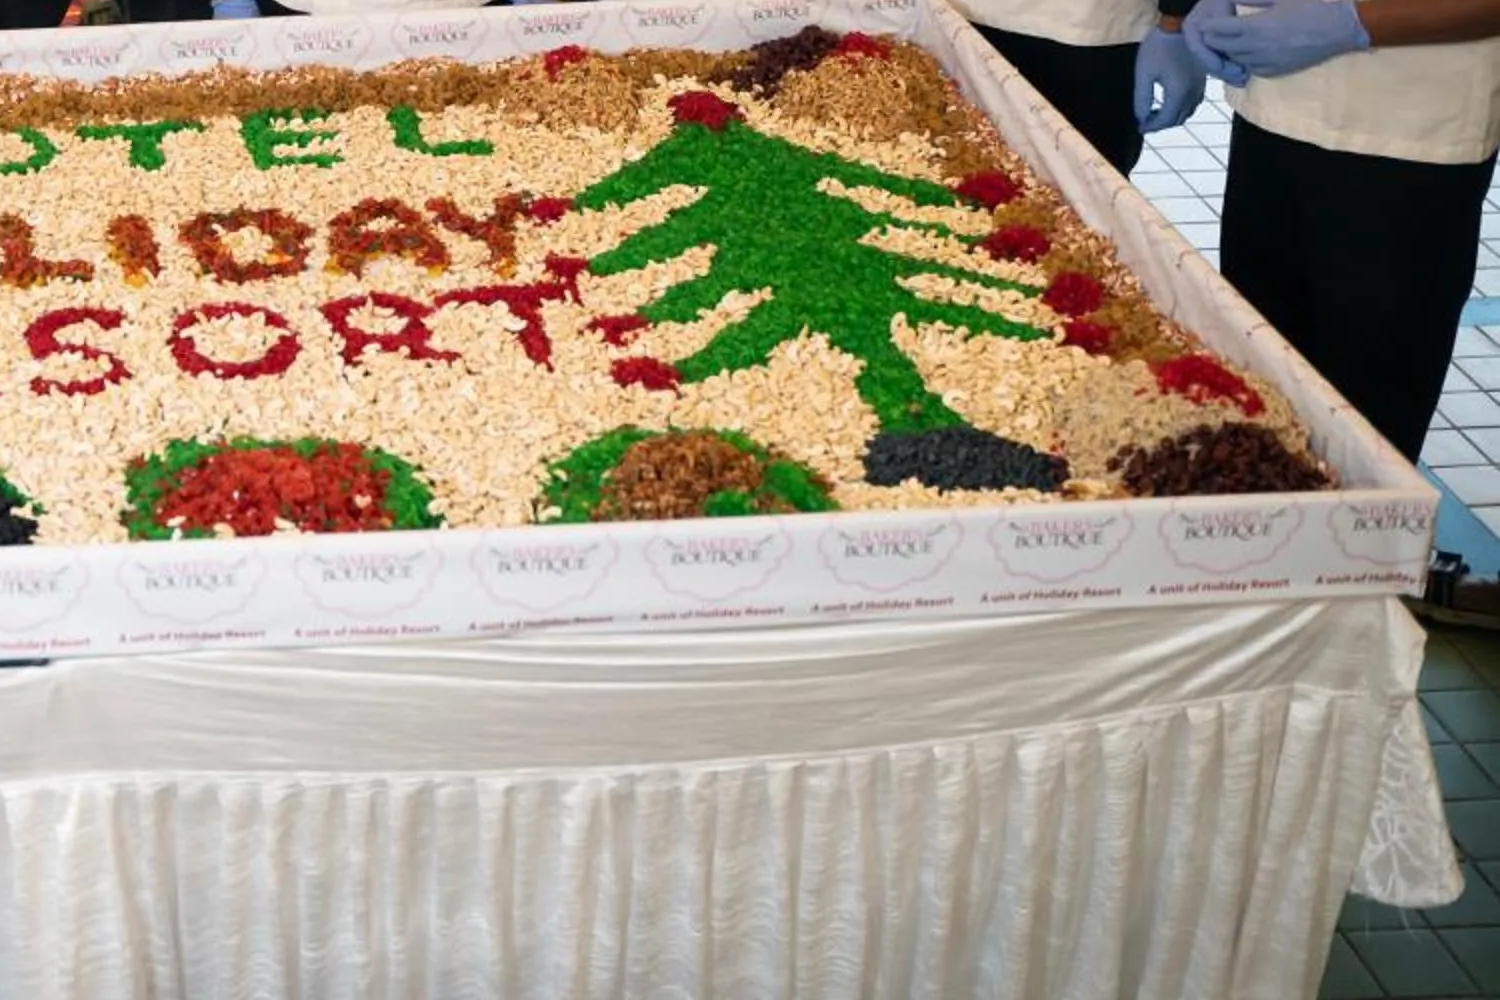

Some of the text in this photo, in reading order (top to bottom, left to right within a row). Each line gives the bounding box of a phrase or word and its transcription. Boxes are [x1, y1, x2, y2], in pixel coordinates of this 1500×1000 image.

[1014, 530, 1104, 550] BOUTIQUE
[1185, 521, 1274, 541] BOUTIQUE
[671, 548, 761, 568] BOUTIQUE
[845, 539, 934, 559] BOUTIQUE
[322, 564, 413, 585] BOUTIQUE
[498, 556, 588, 577] BOUTIQUE
[1148, 583, 1157, 595] A
[1187, 581, 1199, 592] of
